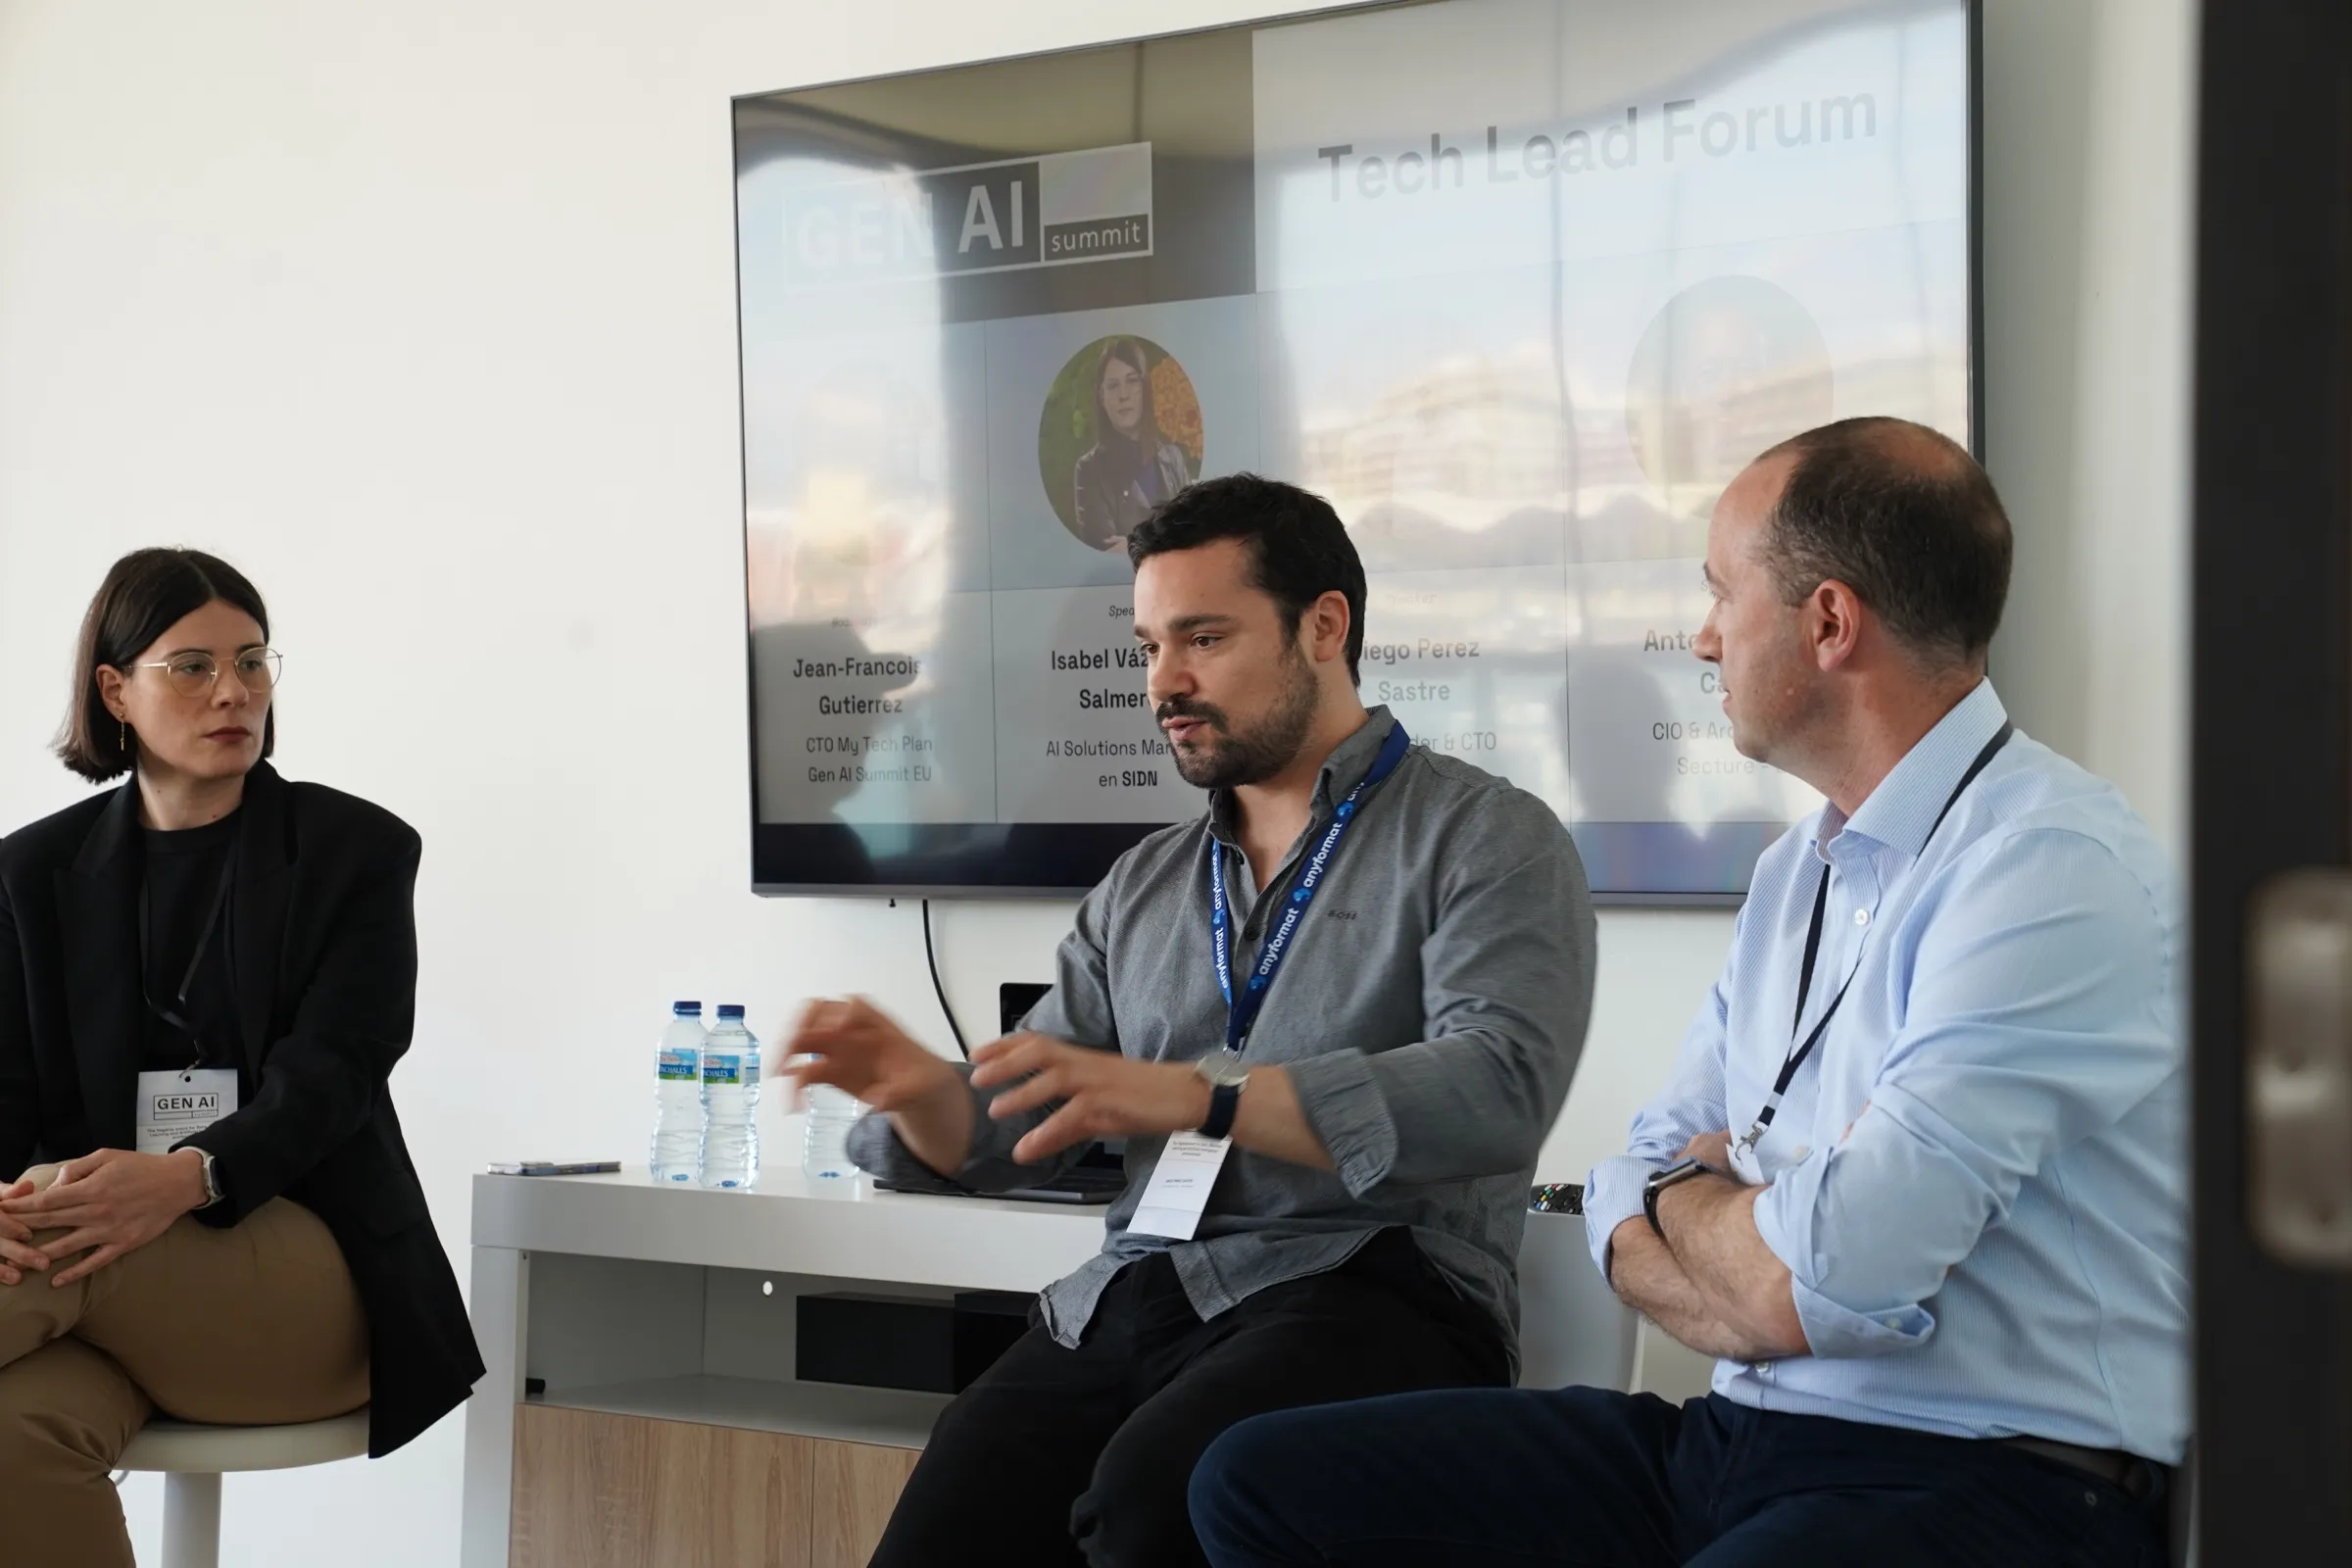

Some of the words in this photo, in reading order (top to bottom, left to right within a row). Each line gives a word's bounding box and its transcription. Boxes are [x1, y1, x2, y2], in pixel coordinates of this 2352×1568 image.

[1317, 131, 1464, 202] Tech
[1486, 105, 1639, 183] Lead
[1662, 92, 1877, 163] Forum
[797, 193, 934, 267] GEN
[957, 179, 1024, 254] AI
[1051, 220, 1142, 253] summit
[1108, 605, 1135, 618] Spea
[1052, 649, 1108, 670] Isabel
[1114, 647, 1149, 668] Váz
[1363, 642, 1410, 665] iego
[1418, 637, 1480, 660] Perez
[793, 655, 922, 677] Jean-Francois
[1079, 688, 1150, 709] Salmer
[1378, 680, 1450, 702] Sastre
[818, 694, 904, 715] Gutierrez
[1461, 730, 1497, 752] CTO
[1652, 721, 1683, 741] CIO
[1706, 720, 1734, 740] Arc
[806, 736, 833, 754] CTO
[838, 736, 859, 757] My
[862, 736, 898, 753] Tech
[902, 735, 932, 753] Plan
[1046, 741, 1059, 757] AI
[1064, 740, 1137, 757] Solutions
[808, 765, 835, 783] Gen
[839, 765, 853, 783] AI
[856, 764, 909, 782] Summit
[913, 764, 932, 782] EU
[1677, 756, 1754, 775] Secture
[1099, 774, 1117, 787] en
[1122, 770, 1157, 787] SIDN
[1303, 822, 1343, 888] anyformat
[1258, 907, 1298, 976] anyformat
[1214, 927, 1229, 989] anyformat
[157, 1098, 193, 1110] GEN
[198, 1096, 215, 1108] AI
